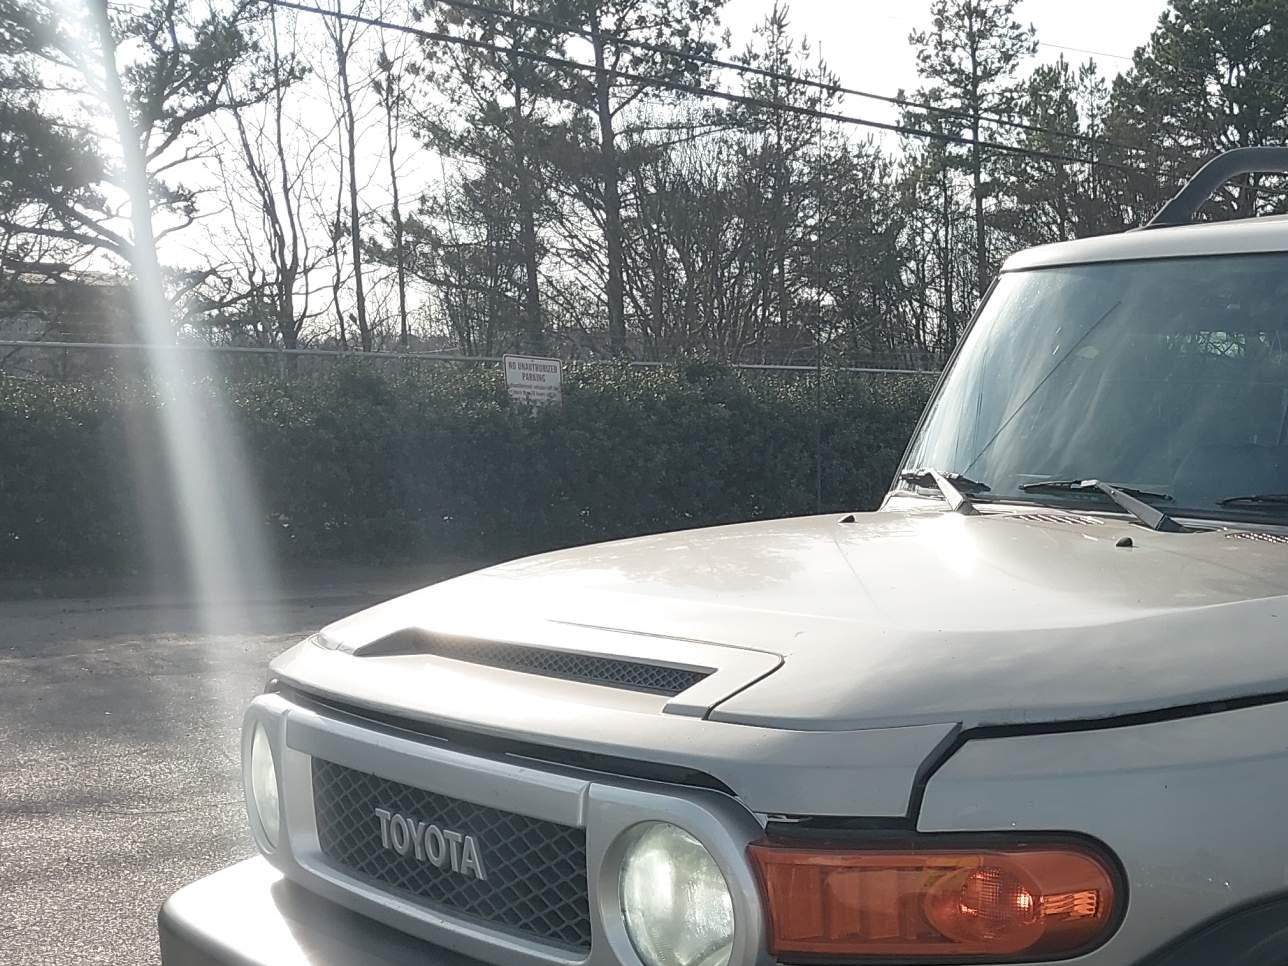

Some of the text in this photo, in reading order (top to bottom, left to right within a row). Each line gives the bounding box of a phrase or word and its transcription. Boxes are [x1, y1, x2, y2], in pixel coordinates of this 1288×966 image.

[508, 361, 517, 369] NO
[522, 372, 545, 382] PARKING
[375, 807, 487, 880] TOYOTA
